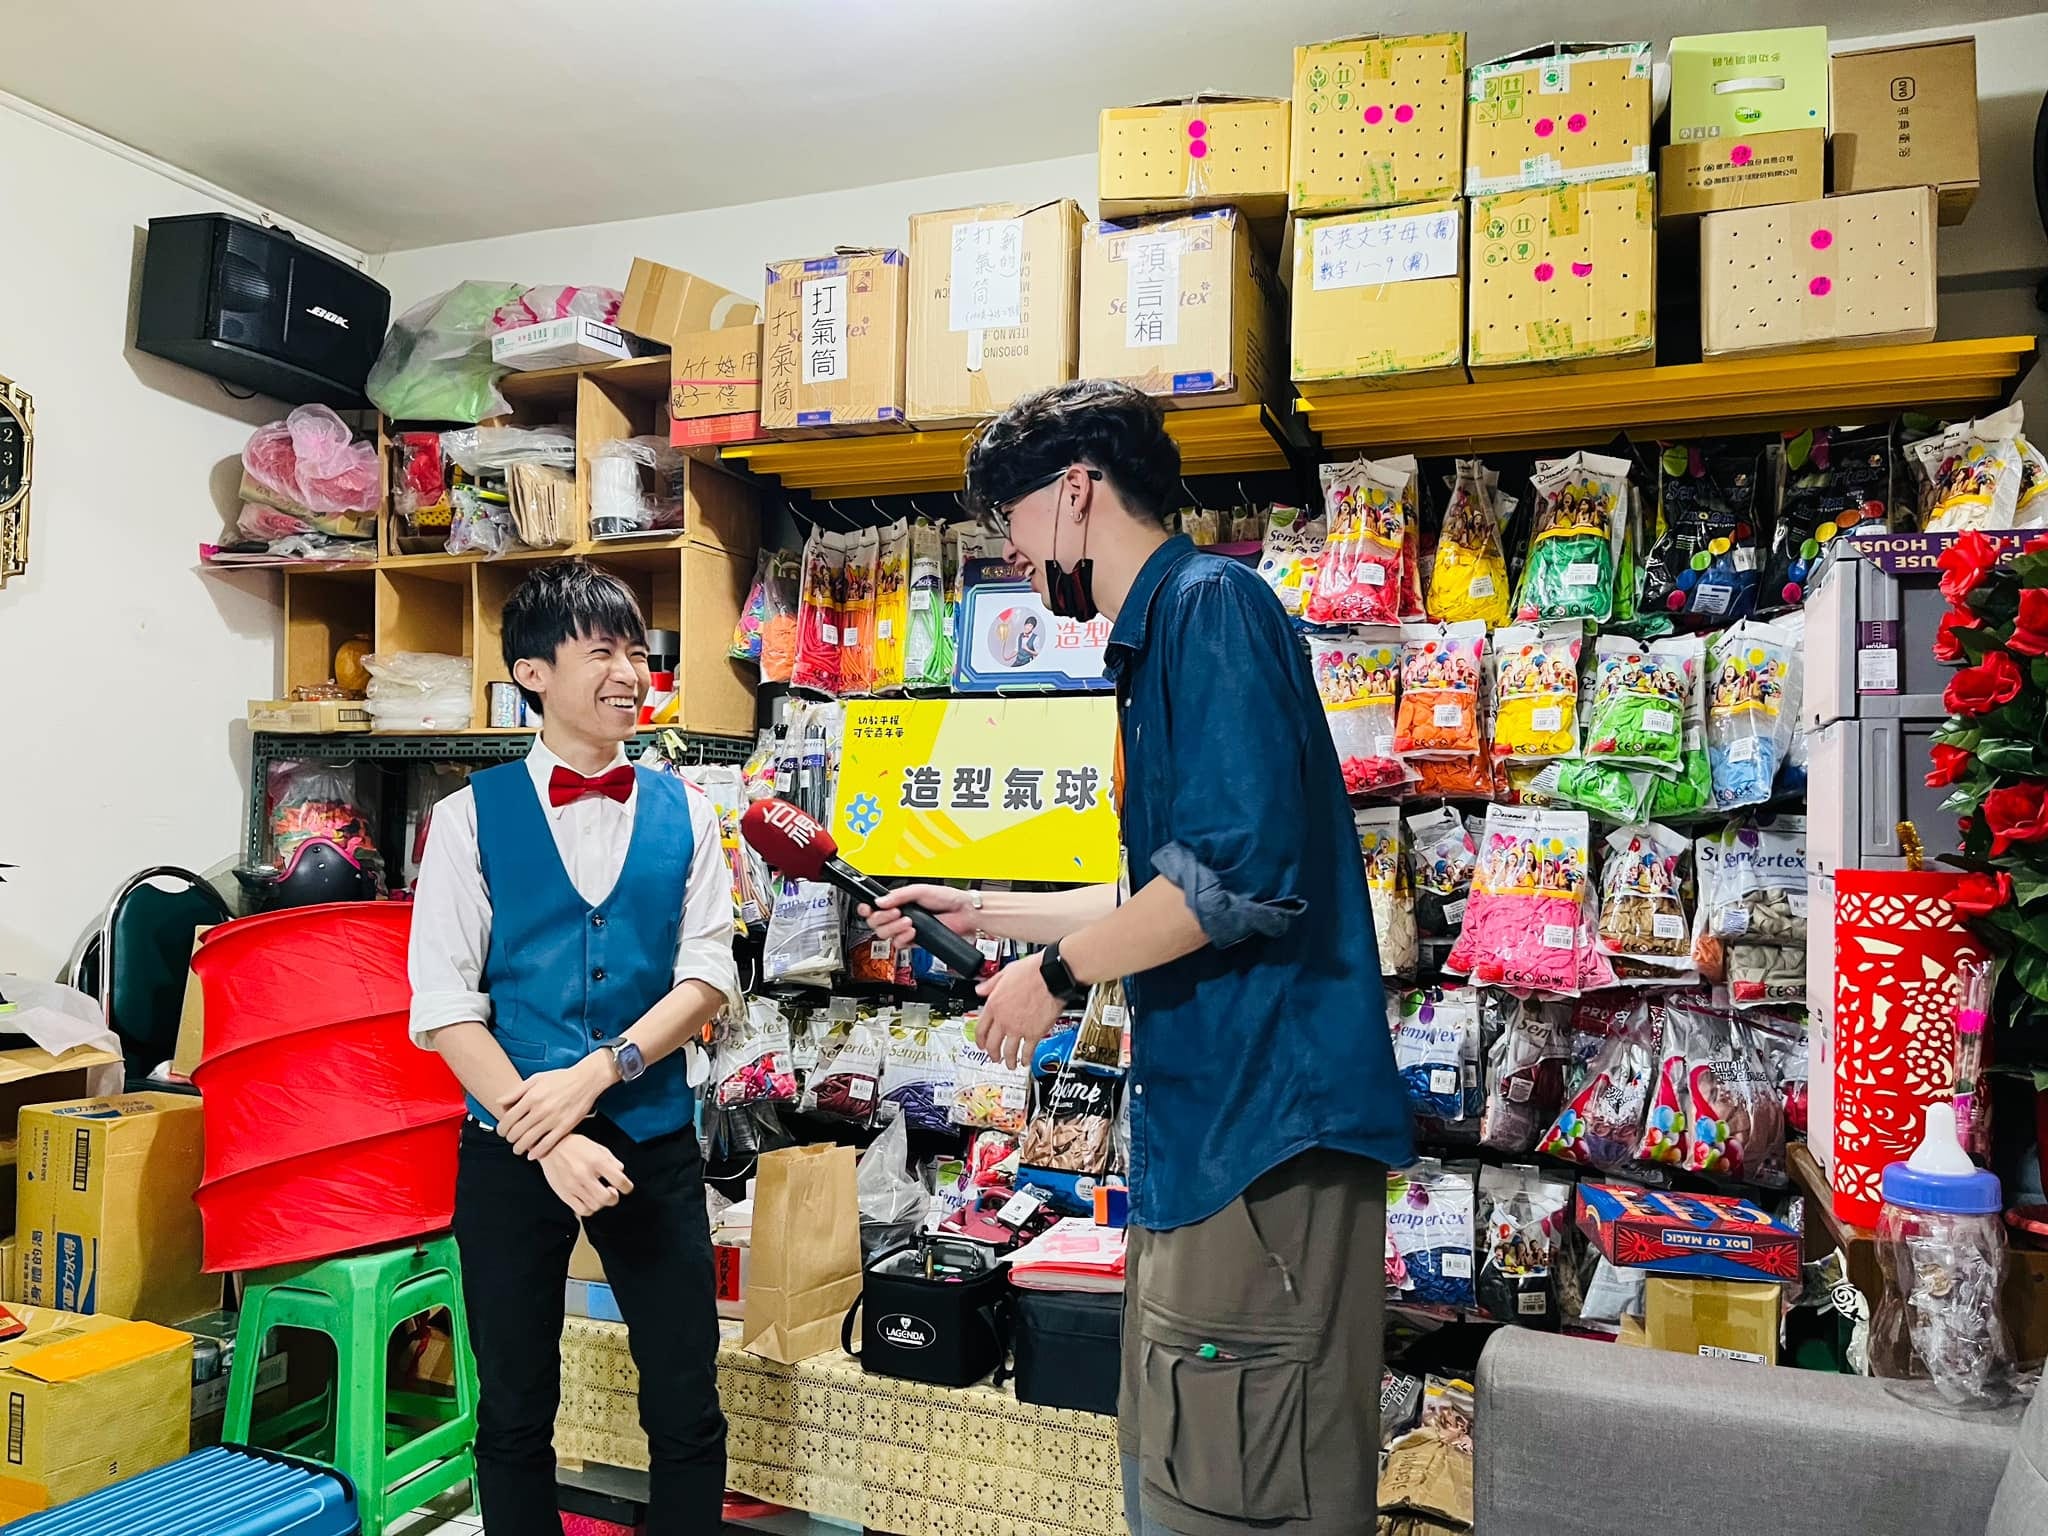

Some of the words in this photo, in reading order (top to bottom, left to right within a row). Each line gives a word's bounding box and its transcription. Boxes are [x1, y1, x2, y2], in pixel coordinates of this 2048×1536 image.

[1134, 242, 1171, 343] 預言箱
[811, 285, 837, 378] 打氣筒
[770, 308, 798, 411] 打氣筒
[983, 345, 1029, 359] BOROSINO
[3, 428, 14, 443] 2
[3, 451, 13, 466] 3
[1055, 621, 1110, 649] 造型
[900, 766, 1118, 812] 造型氣球
[1666, 1233, 1702, 1245] MAGIC
[1706, 1237, 1721, 1248] OF
[1724, 1238, 1749, 1249] BOX
[886, 1326, 925, 1342] LAGENDA
